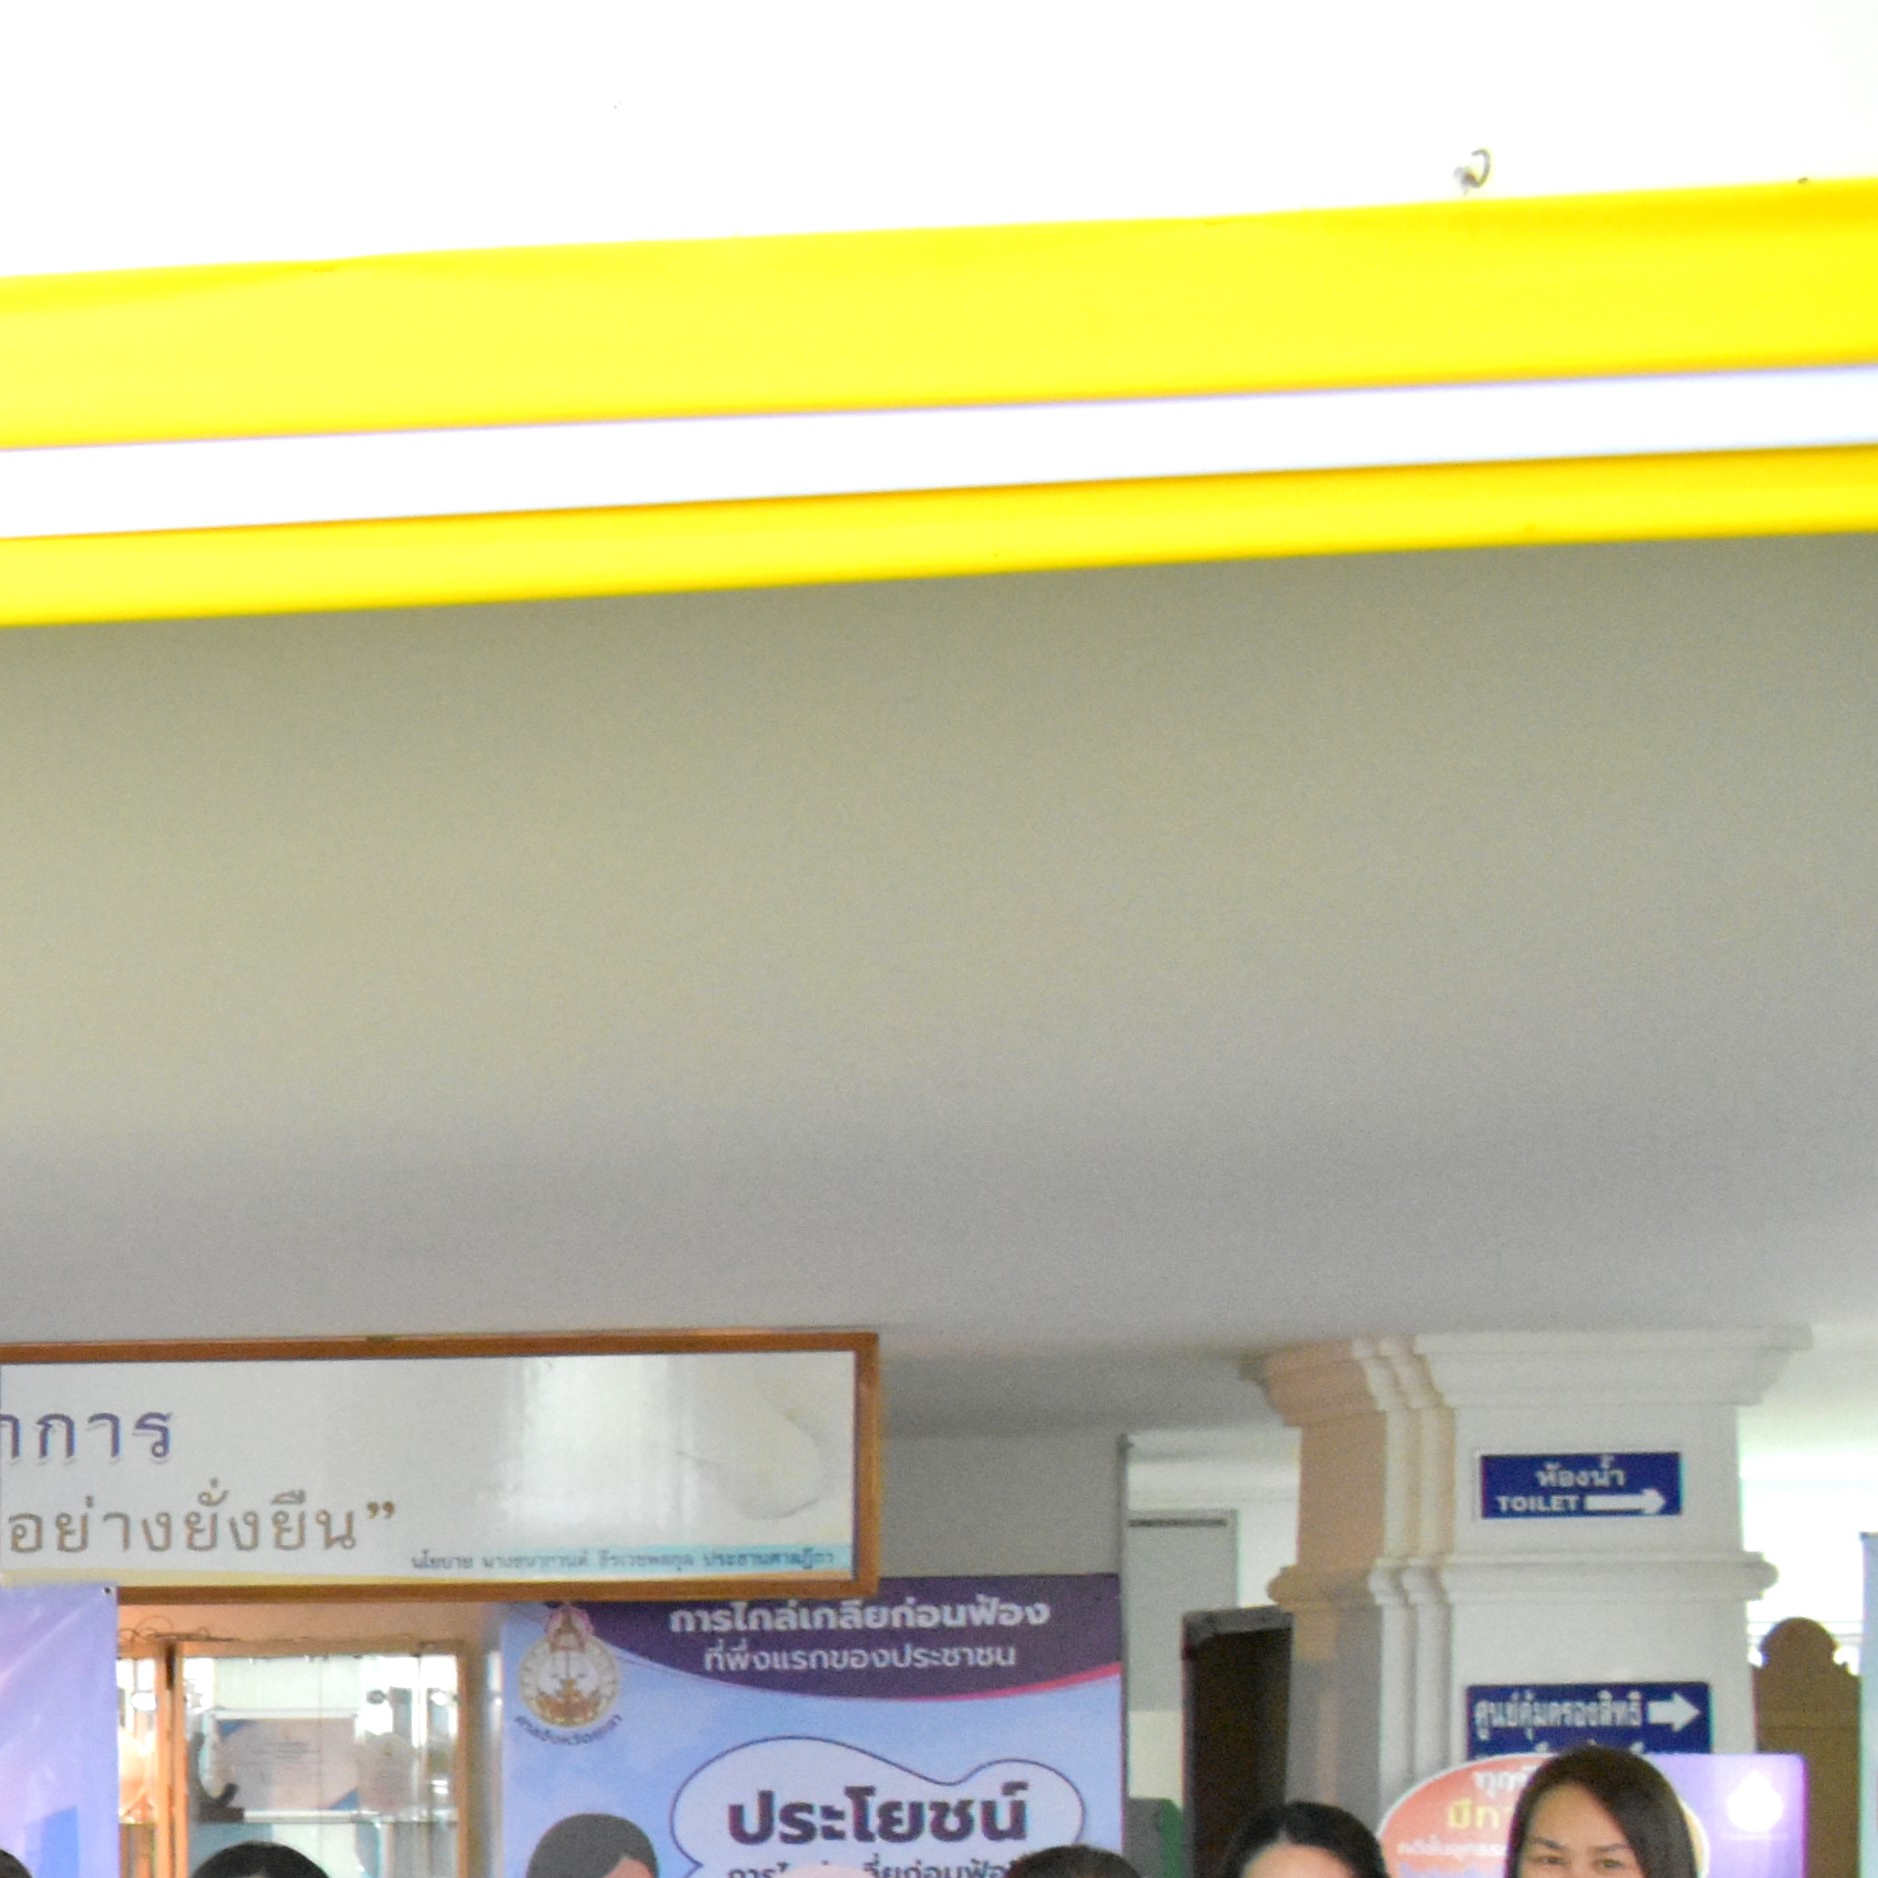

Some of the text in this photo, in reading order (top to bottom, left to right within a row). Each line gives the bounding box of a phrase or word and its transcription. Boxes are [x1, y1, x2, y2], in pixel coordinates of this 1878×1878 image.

[1536, 1455, 1626, 1488] ห้องน้ำ
[1496, 1495, 1580, 1513] TOILET
[703, 1642, 1017, 1672] ที่พึ่งแรกของประชาชน
[728, 1781, 1029, 1845] ประโยชน์
